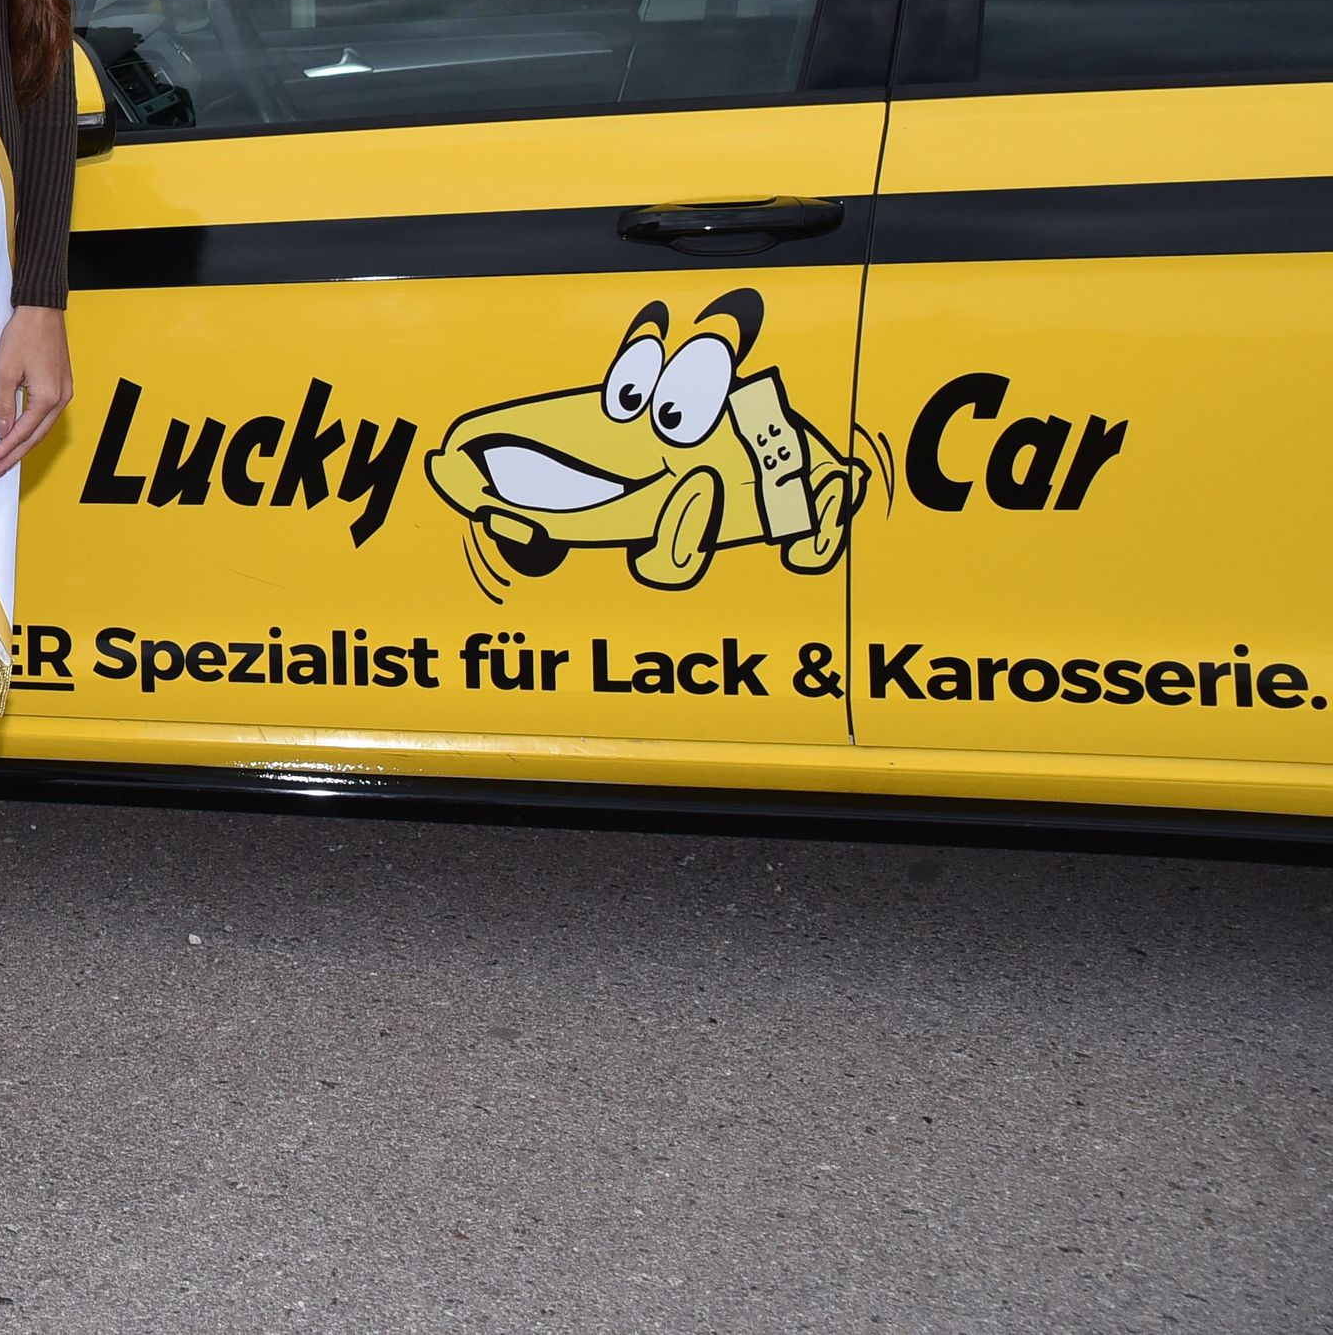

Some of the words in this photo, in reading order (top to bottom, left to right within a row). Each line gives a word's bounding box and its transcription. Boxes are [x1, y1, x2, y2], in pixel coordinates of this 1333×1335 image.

[79, 376, 419, 549] Lucky
[905, 371, 1129, 513] Car
[92, 625, 440, 693] Spezialist
[459, 631, 571, 692] für
[591, 637, 770, 697] Lack
[792, 640, 845, 701] &
[867, 643, 1329, 710] Karosserie.
